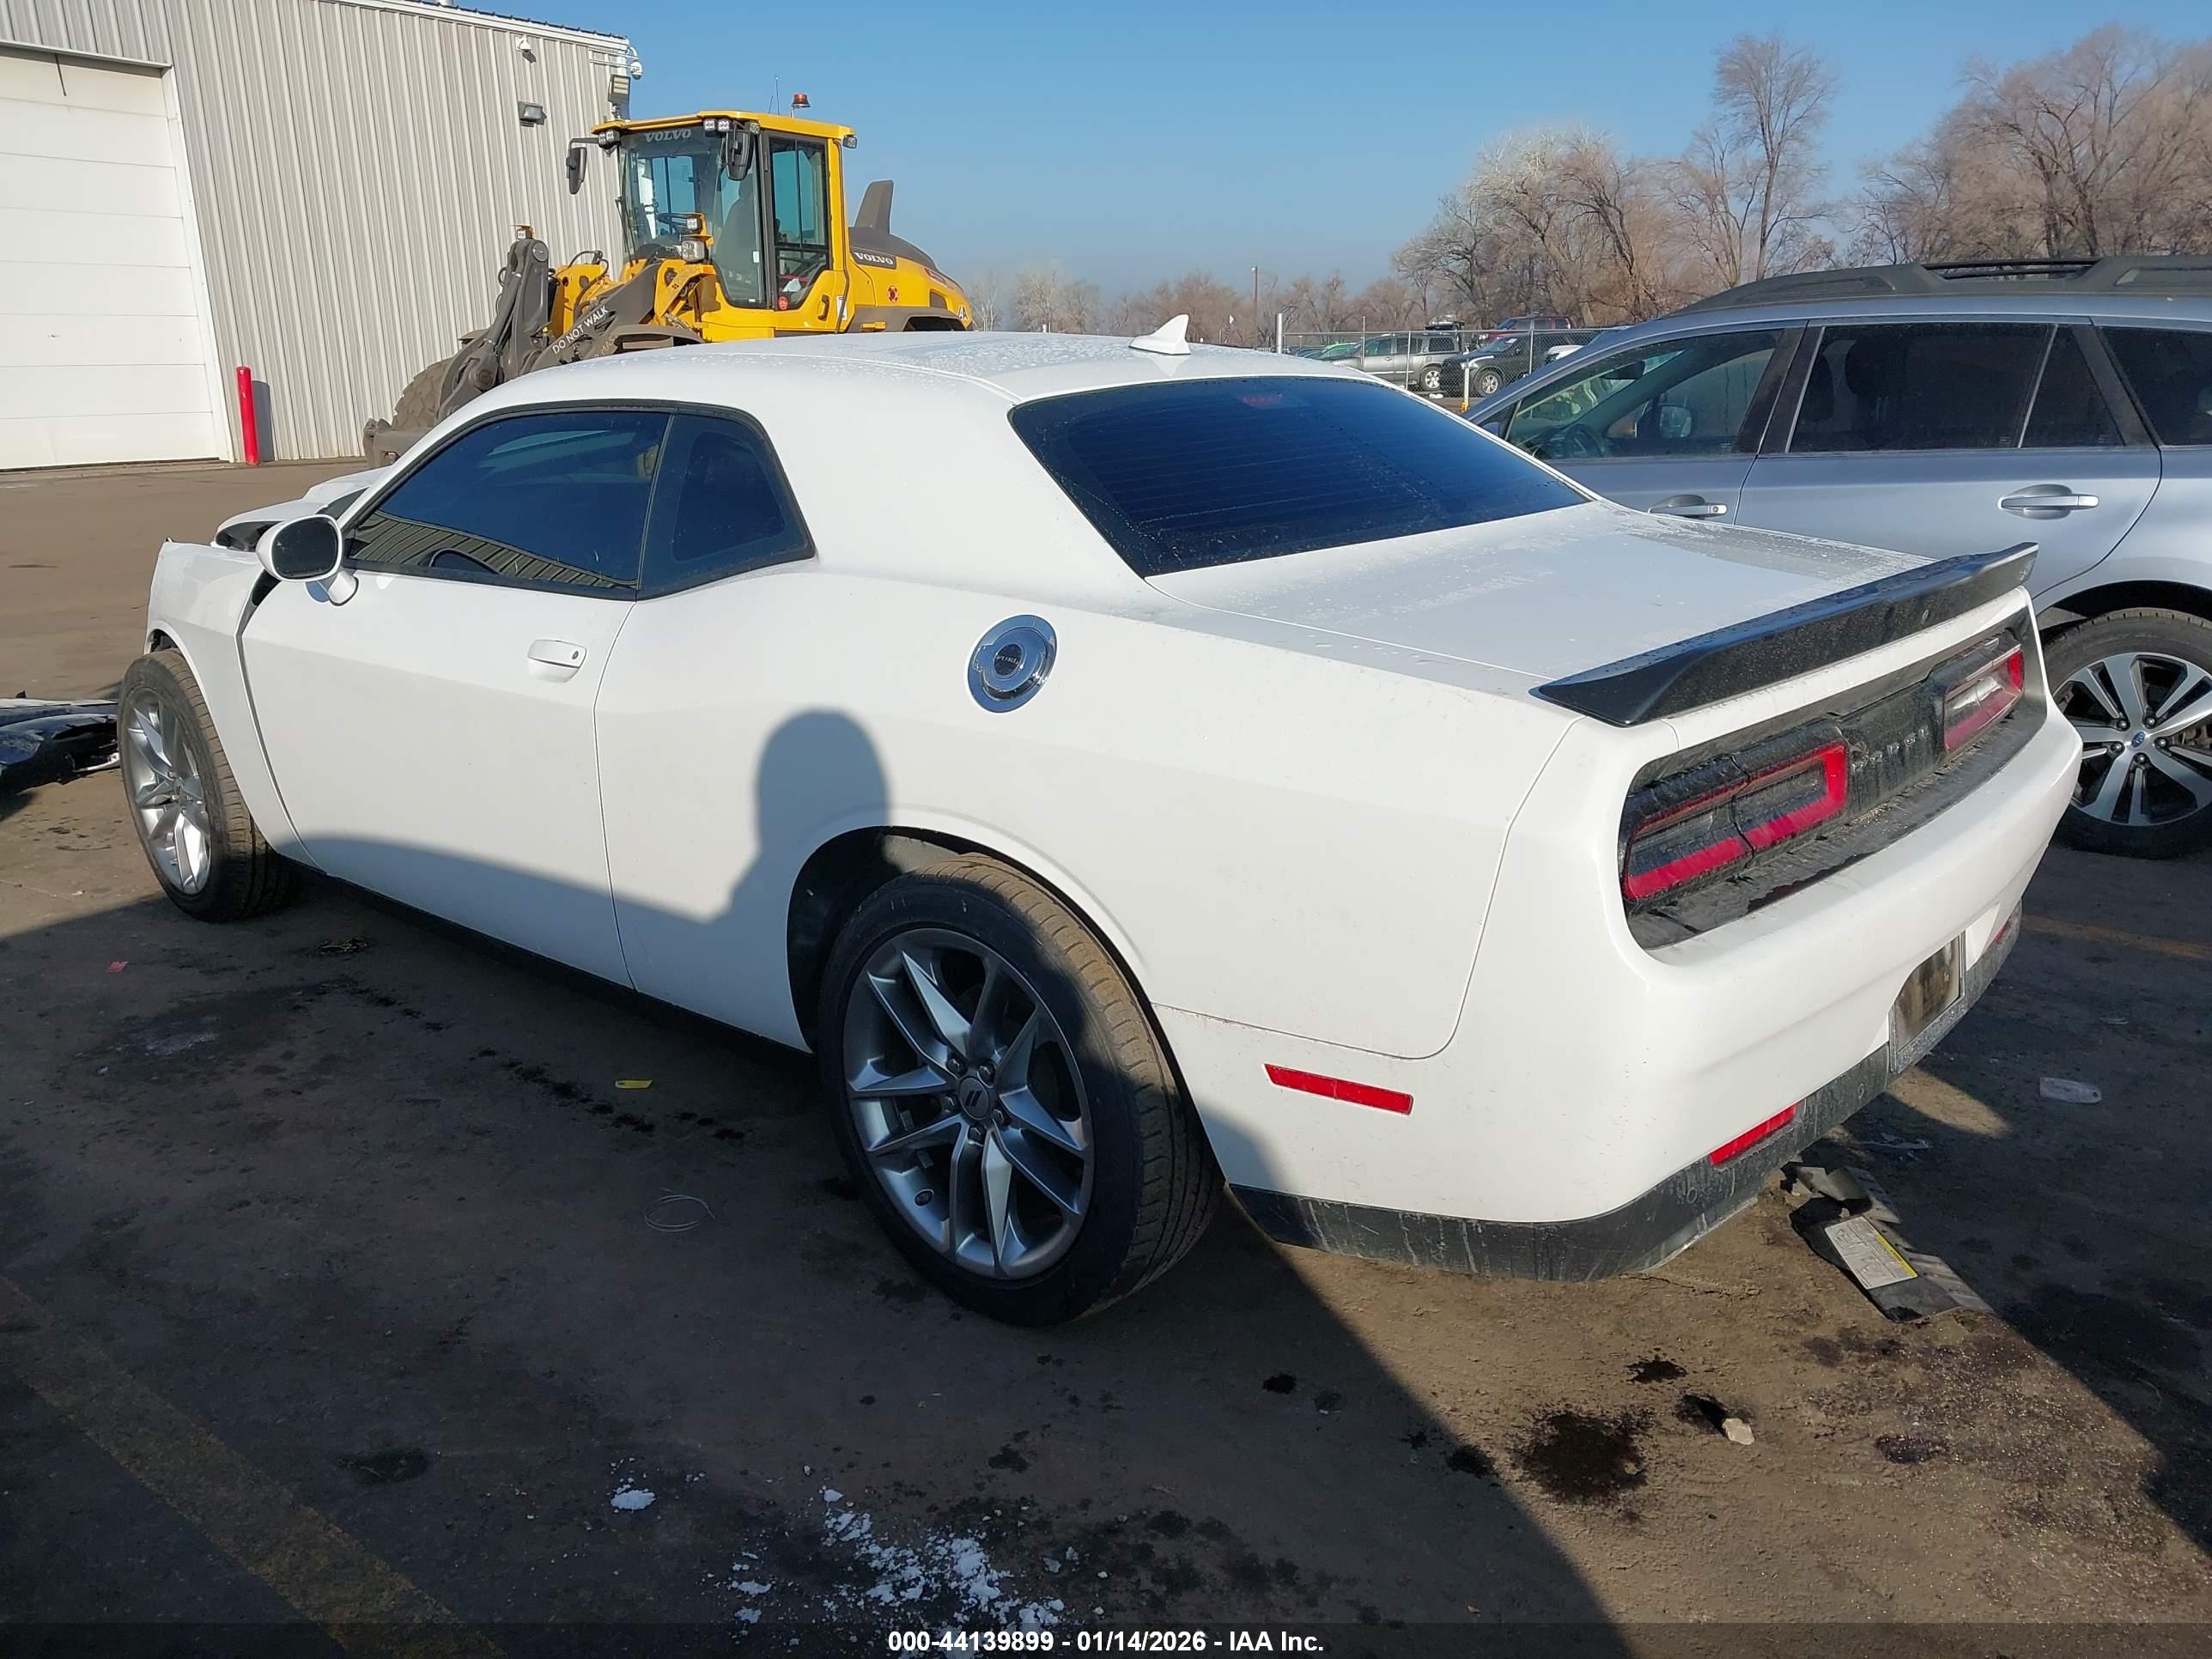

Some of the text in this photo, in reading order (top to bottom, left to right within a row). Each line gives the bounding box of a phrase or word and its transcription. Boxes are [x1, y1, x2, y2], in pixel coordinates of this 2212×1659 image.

[646, 129, 691, 143] VOLVO
[854, 252, 893, 264] VOLVO
[552, 305, 609, 355] DO NOT WALK
